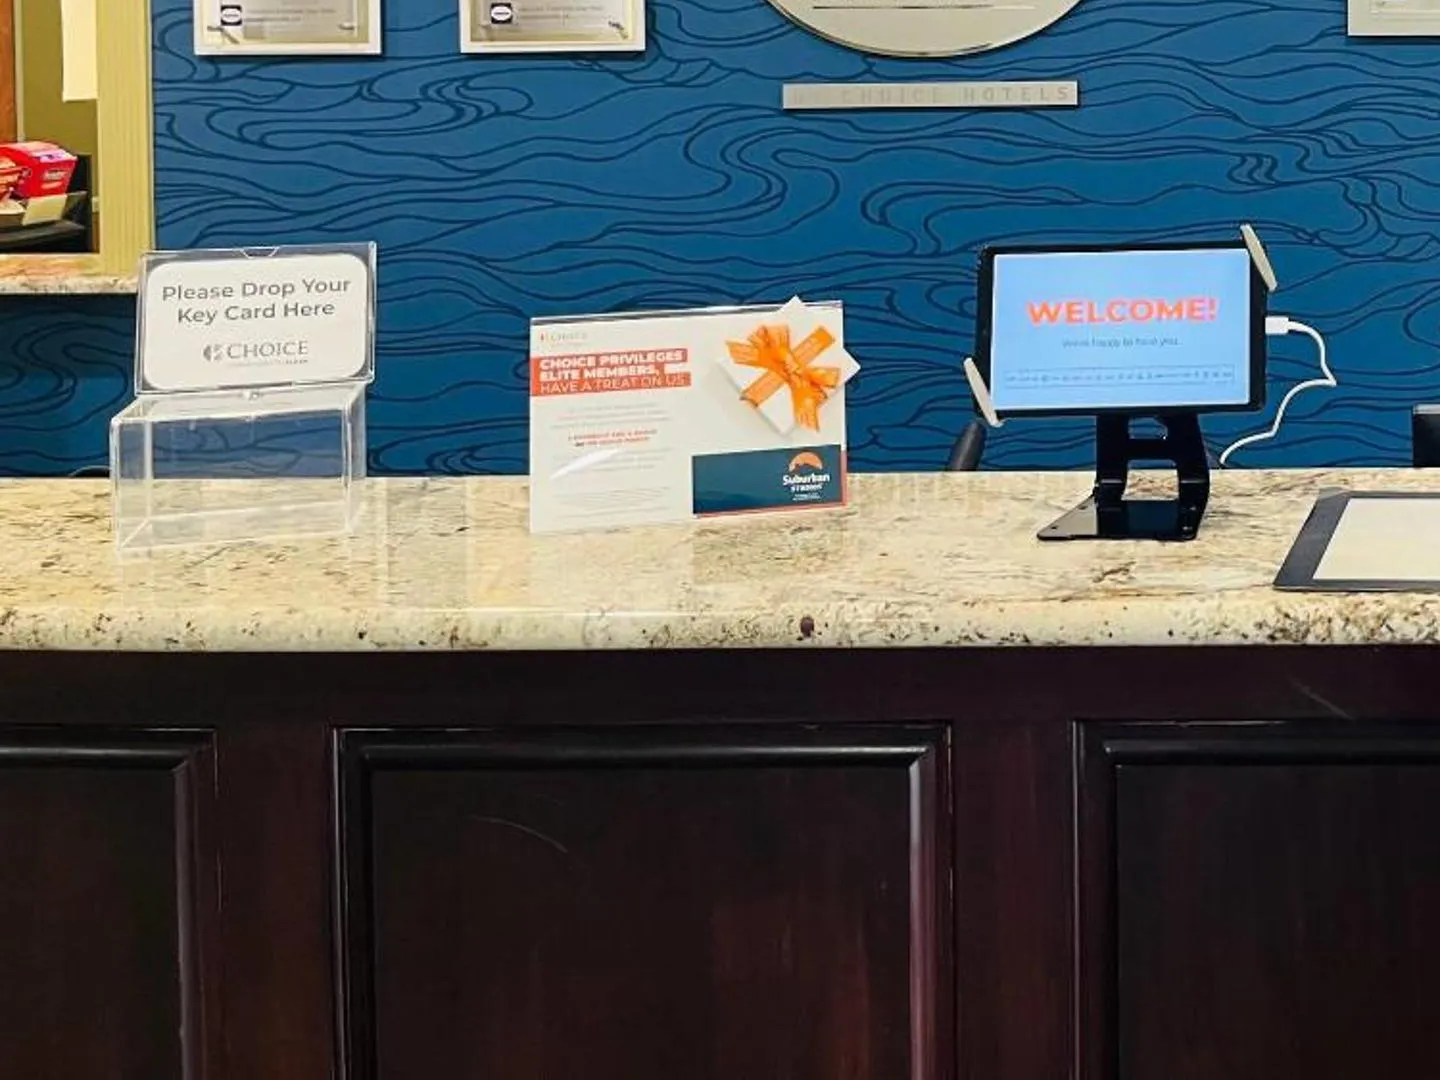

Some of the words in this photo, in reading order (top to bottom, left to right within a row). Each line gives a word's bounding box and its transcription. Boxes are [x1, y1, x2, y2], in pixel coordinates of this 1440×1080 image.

[963, 86, 1069, 102] HOTELS
[162, 284, 234, 301] Please
[241, 281, 295, 299] Drop
[302, 278, 351, 294] Your
[178, 307, 218, 326] Key
[224, 303, 276, 321] Card
[283, 300, 335, 317] Here
[1027, 297, 1218, 326] WELCOME!
[227, 340, 308, 359] CHOICE
[539, 355, 596, 371] CHOICE
[599, 350, 684, 366] PRIVILEGES
[539, 368, 580, 382] ELITE
[539, 381, 579, 394] HAVE
[580, 379, 592, 392] A
[592, 377, 640, 391] TREAT
[641, 375, 663, 389] ON
[665, 373, 687, 387] US
[782, 473, 831, 486] Suburban
